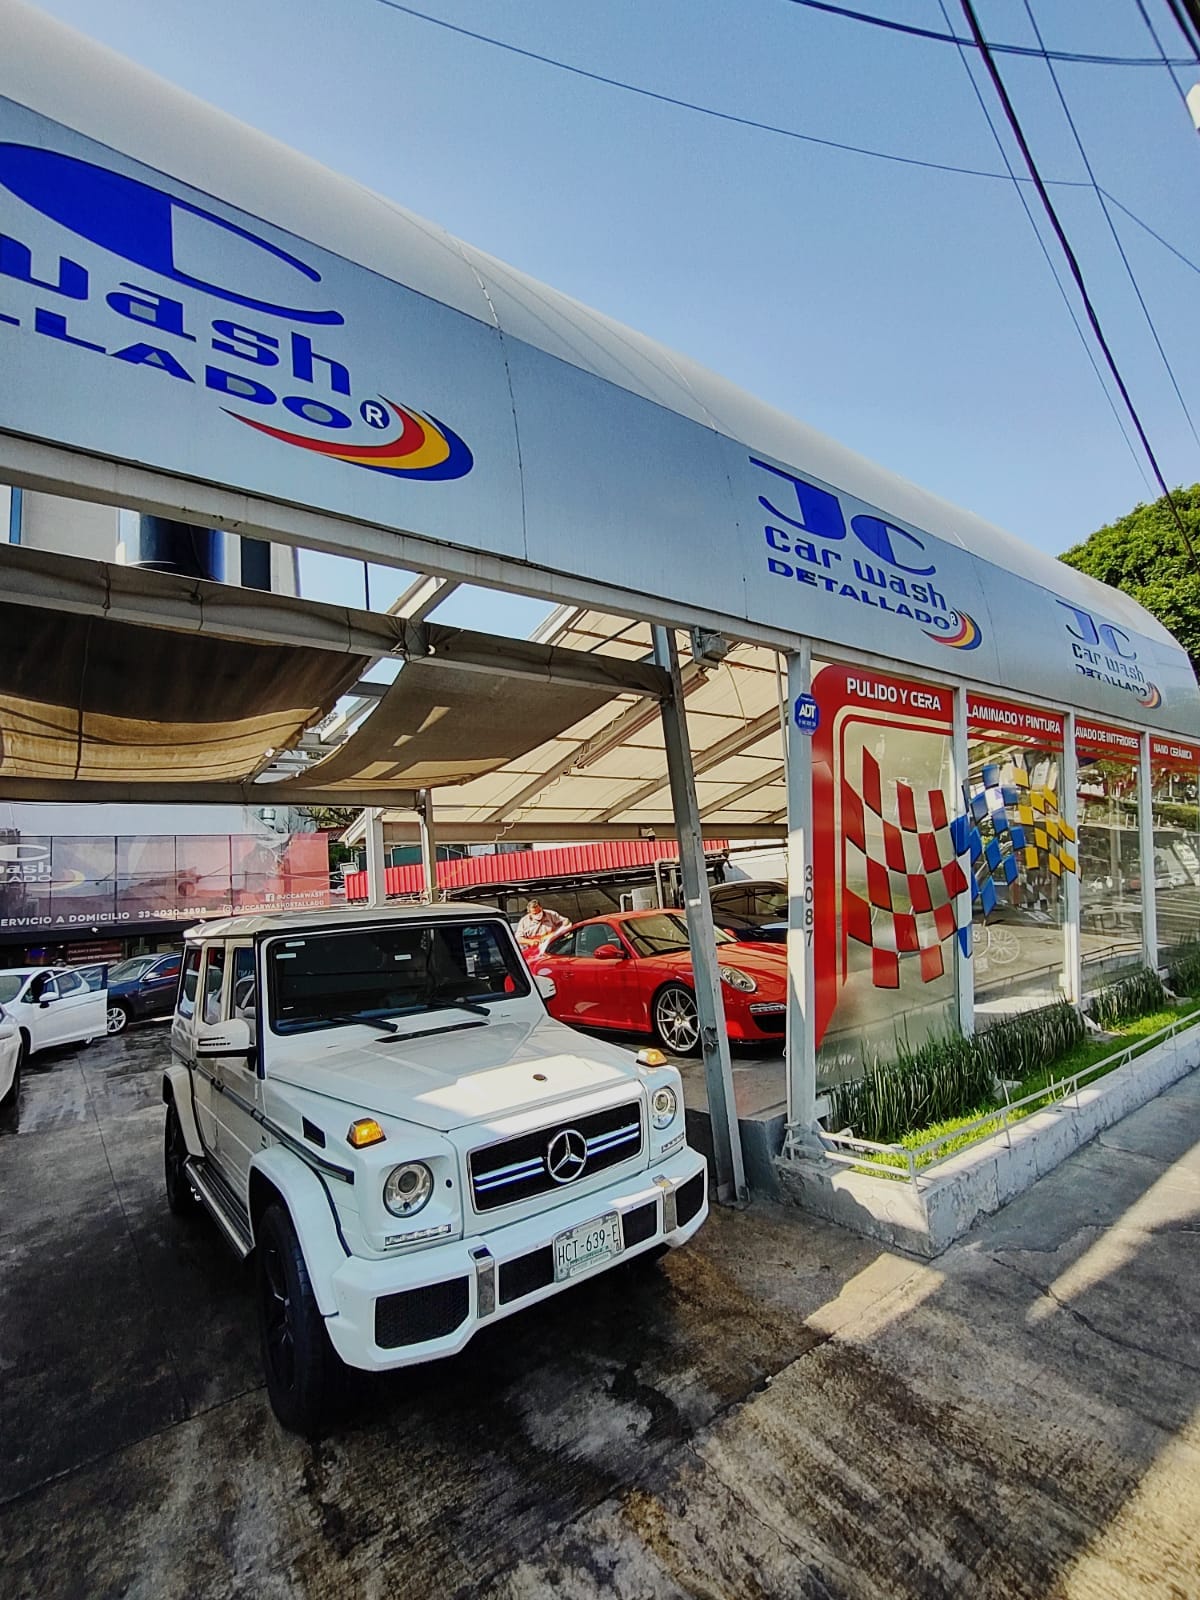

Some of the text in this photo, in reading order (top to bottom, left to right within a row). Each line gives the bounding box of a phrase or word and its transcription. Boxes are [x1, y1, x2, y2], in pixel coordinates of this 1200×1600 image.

[748, 455, 937, 577] JC
[767, 557, 950, 630] DETALLADO
[853, 558, 948, 612] wash
[1055, 599, 1137, 661] JC
[1075, 664, 1147, 697] DETALLADO
[1104, 656, 1146, 684] wash
[846, 677, 942, 711] PULIDO Y CERA
[798, 703, 817, 719] ADT
[1017, 713, 1024, 727] Y
[1025, 715, 1061, 734] PINTURA
[1075, 726, 1139, 749] AVADO DE INTERIORES
[0, 916, 52, 927] ERVICIO
[56, 915, 65, 923] A
[69, 912, 130, 923] DOMICILIO
[805, 864, 814, 948] 3087
